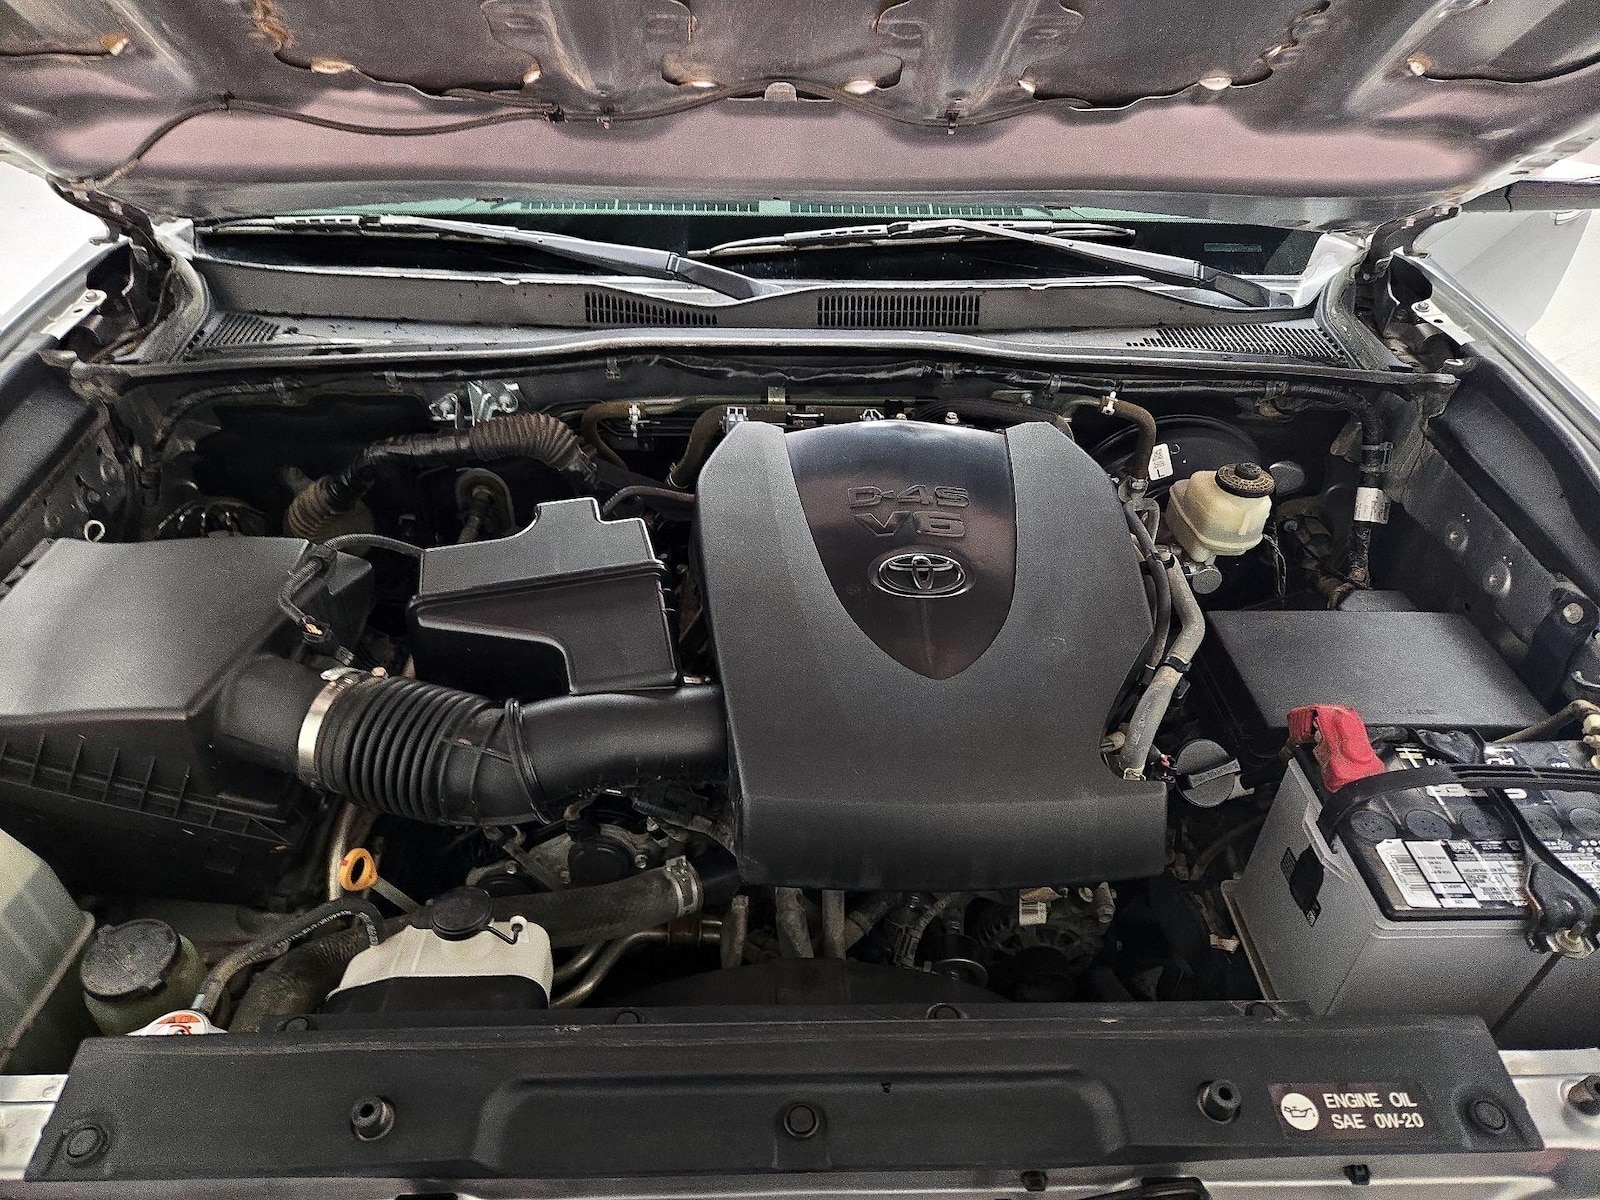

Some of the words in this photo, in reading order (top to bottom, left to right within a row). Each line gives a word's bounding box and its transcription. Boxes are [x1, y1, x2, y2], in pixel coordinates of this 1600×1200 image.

[847, 484, 970, 508] D-4S
[853, 510, 967, 538] V6
[1323, 1092, 1383, 1109] ENGINE
[1388, 1092, 1418, 1108] OIL
[1331, 1113, 1366, 1130] SAE
[1374, 1112, 1424, 1129] 0W-20
